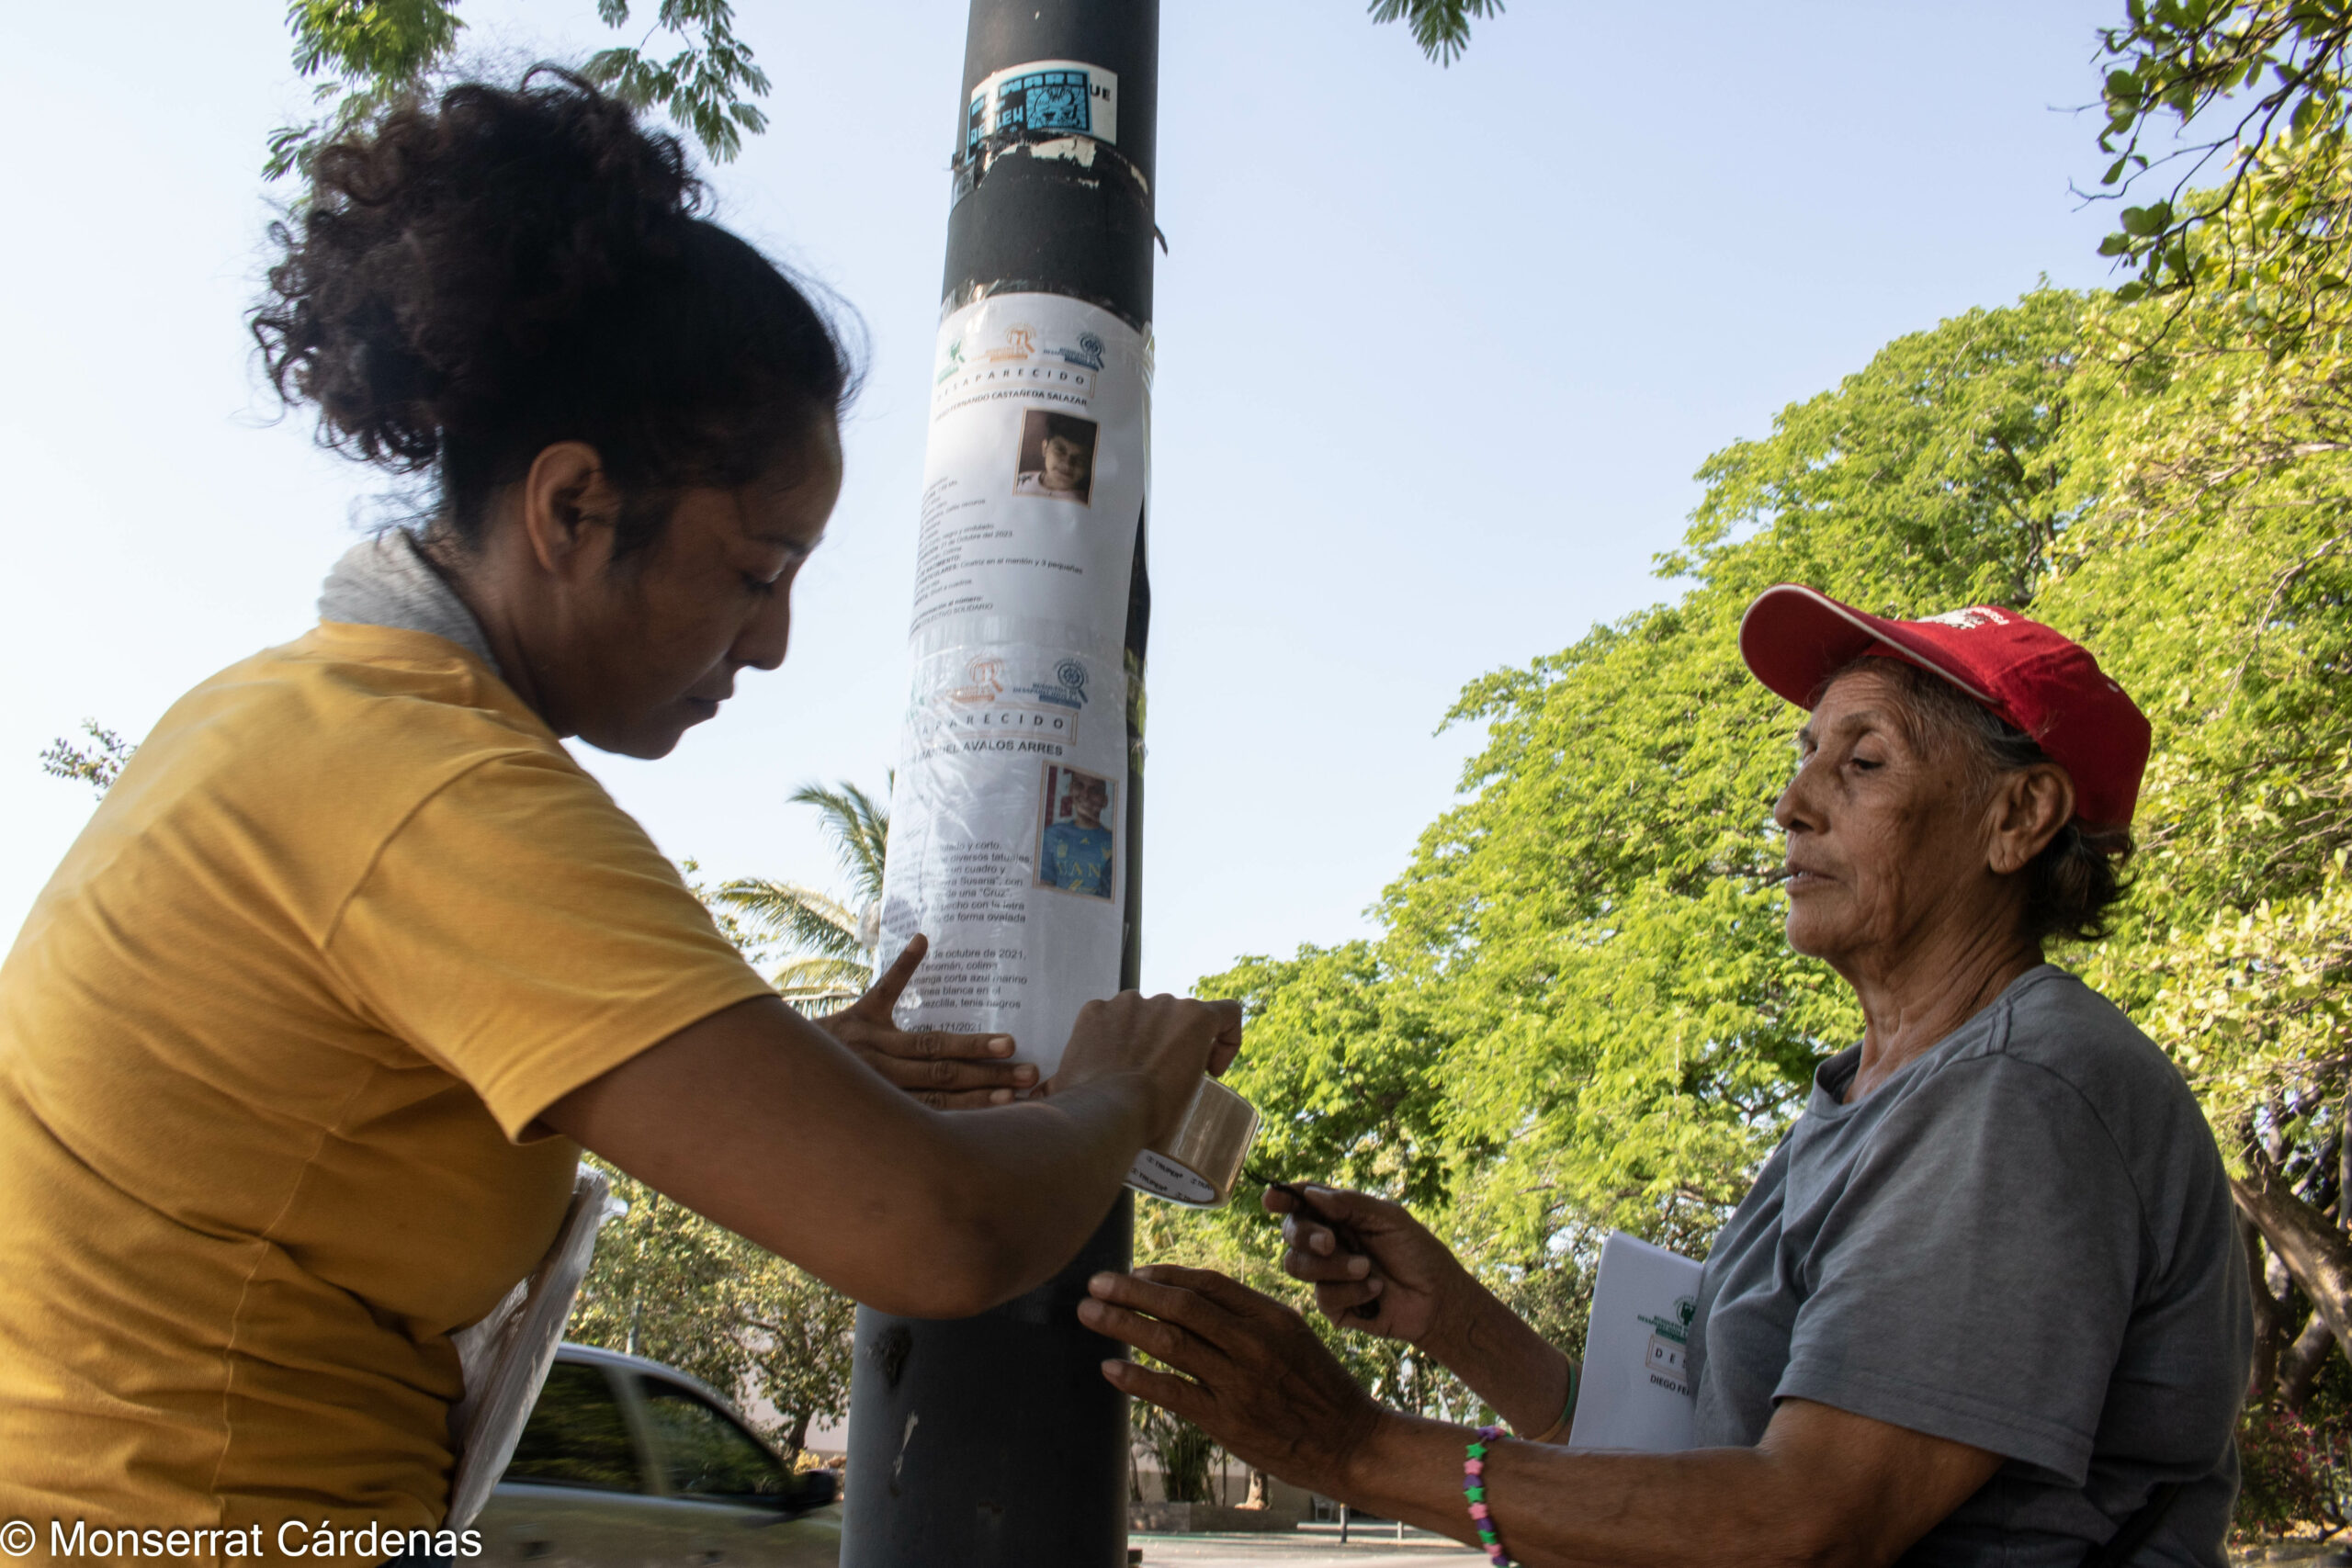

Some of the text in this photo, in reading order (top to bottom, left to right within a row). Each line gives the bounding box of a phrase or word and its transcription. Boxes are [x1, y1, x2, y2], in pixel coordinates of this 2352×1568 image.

[991, 388, 1046, 400] CASTAÑEDA
[1046, 391, 1088, 407] SALAZAR
[1047, 560, 1084, 575] pequeñas
[962, 739, 1015, 752] AVALOS
[1017, 739, 1064, 757] ARRES
[965, 864, 998, 874] cuadro
[1000, 866, 1007, 875] y
[1004, 878, 1024, 887] con
[959, 890, 978, 898] una
[971, 902, 989, 911] con
[1002, 901, 1025, 911] letra
[944, 911, 1027, 924] de forma ovalada
[945, 948, 982, 960] octubre
[983, 948, 997, 958] de
[913, 973, 1029, 987] manga corta azul marino
[943, 985, 975, 996] blanca
[977, 987, 989, 995] en
[961, 998, 984, 1009] tenis
[986, 998, 1023, 1010] negros
[940, 1021, 983, 1033] 171/2021
[1650, 1374, 1677, 1391] DIEGO
